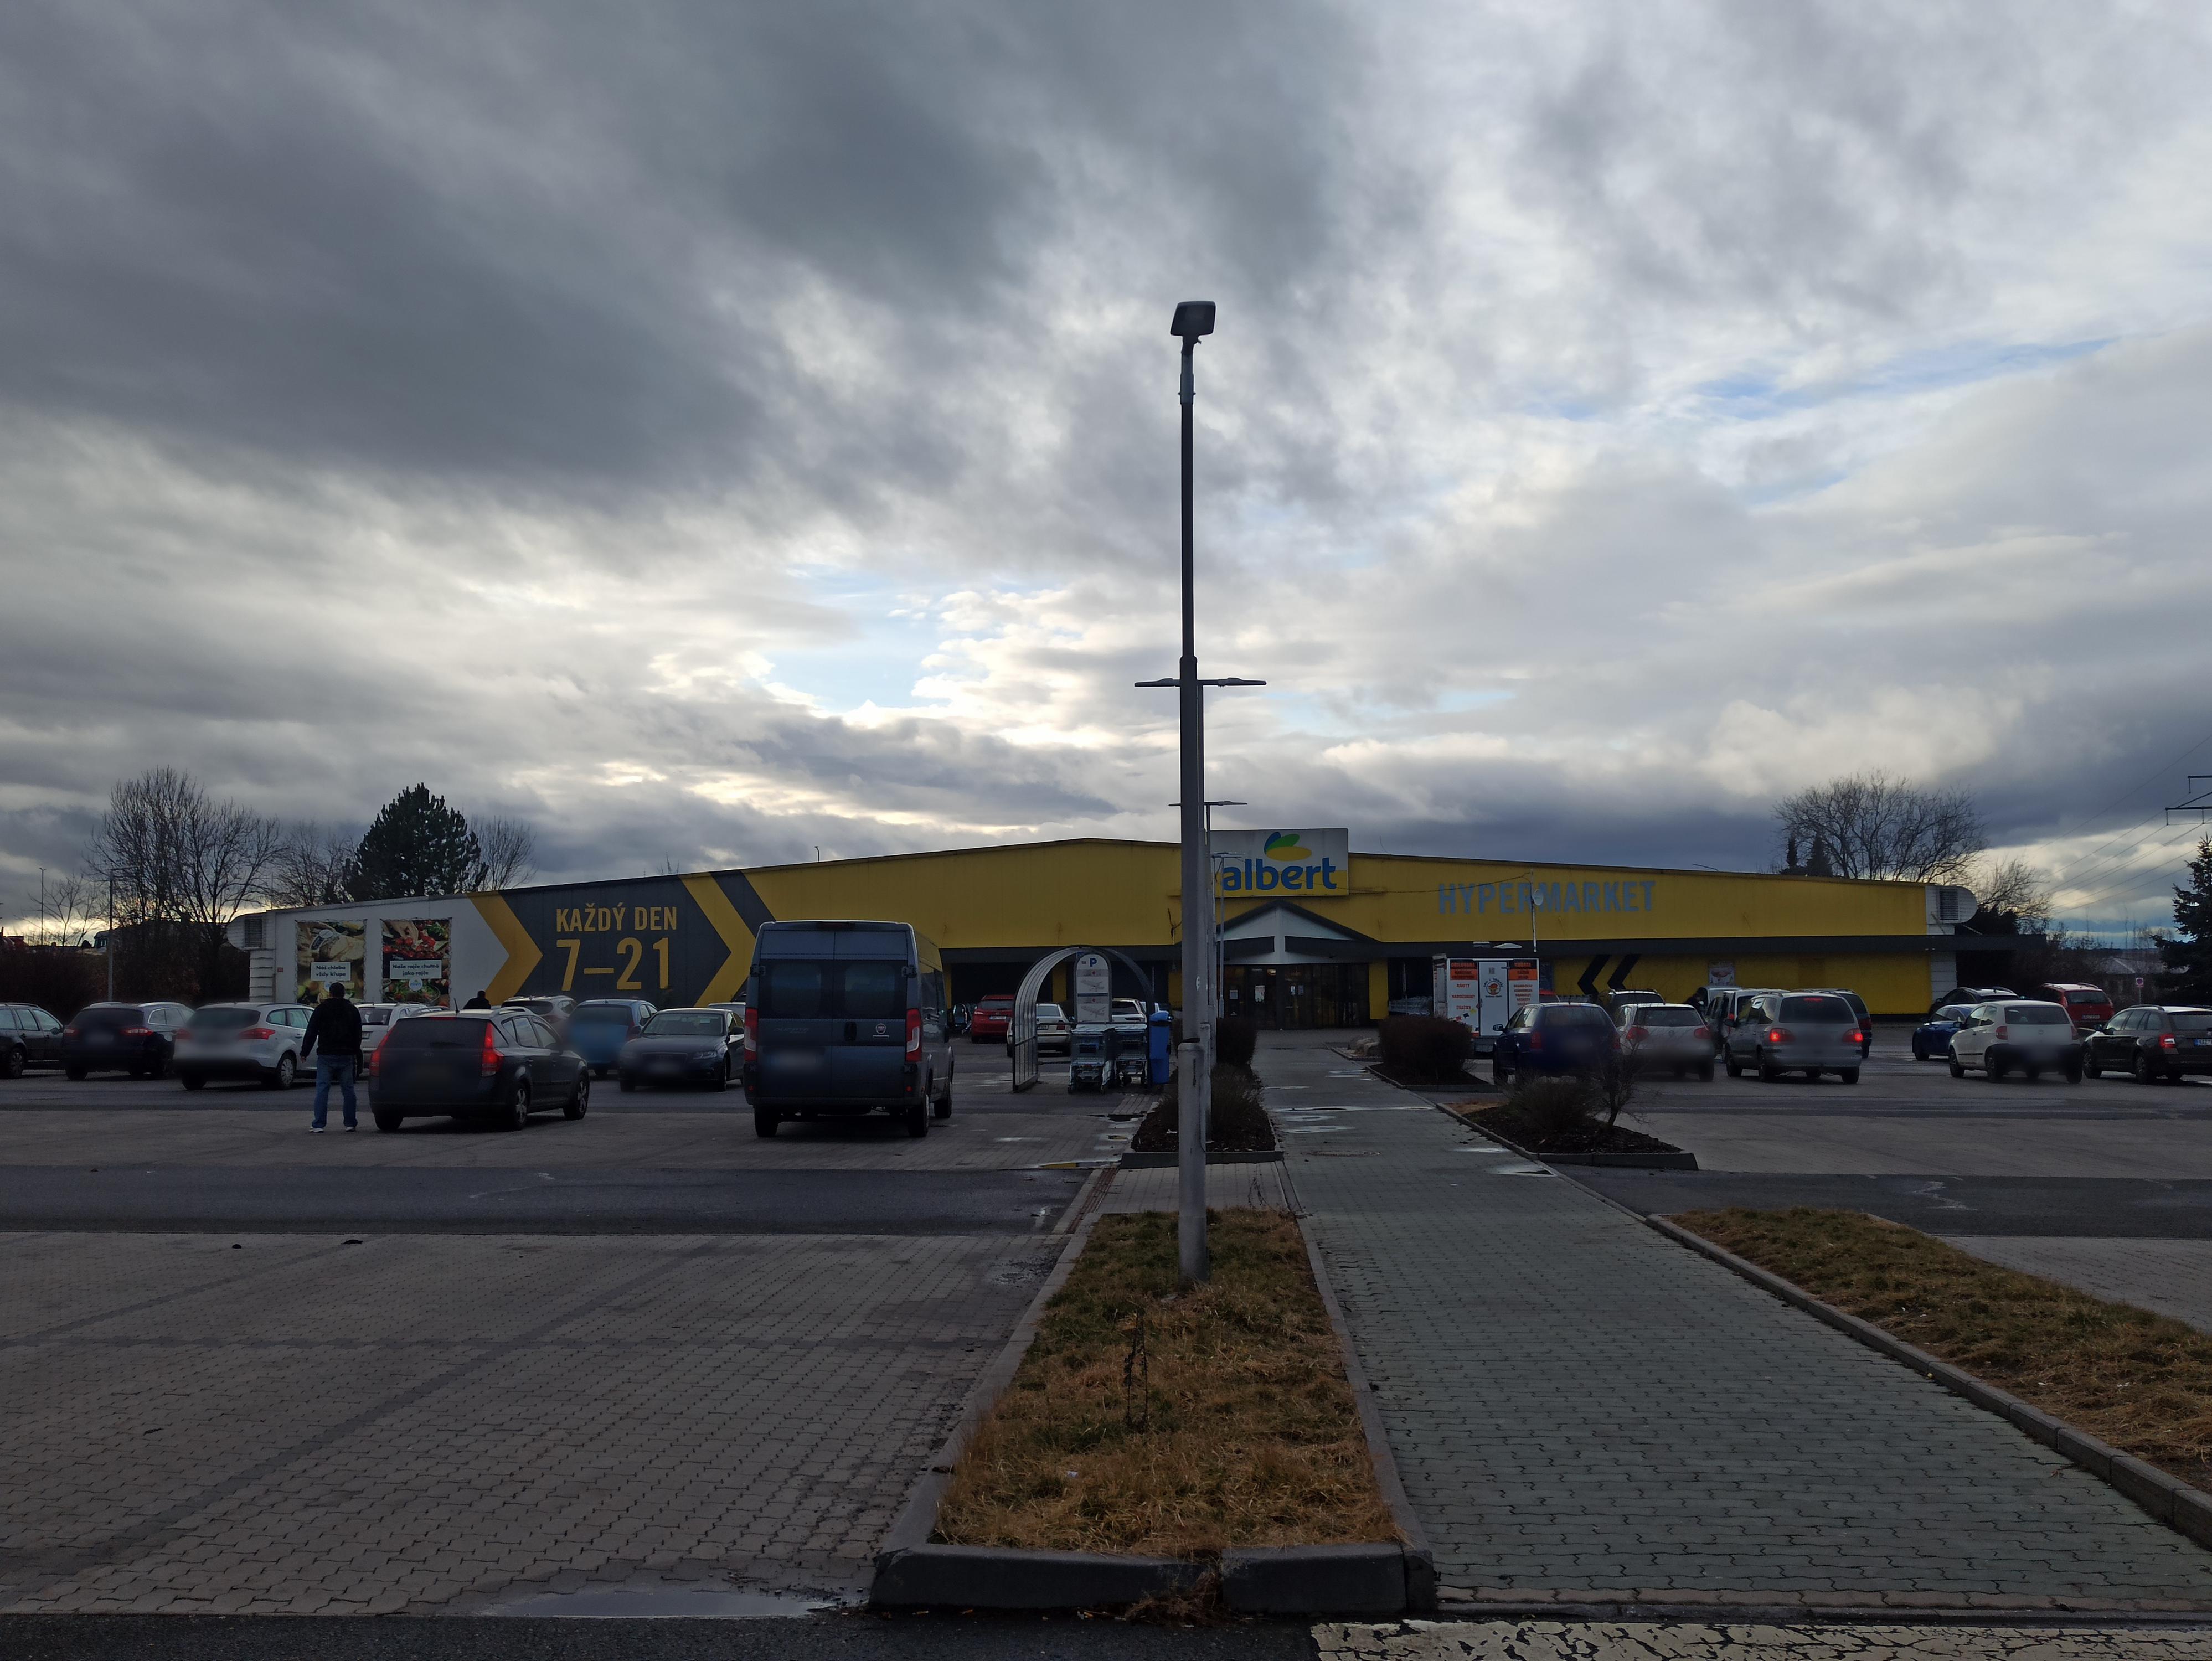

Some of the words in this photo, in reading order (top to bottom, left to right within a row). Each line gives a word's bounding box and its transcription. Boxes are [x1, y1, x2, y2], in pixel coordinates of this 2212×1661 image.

[1222, 857, 1337, 891] albert
[1438, 880, 1656, 915] HYPERMARKET
[556, 902, 626, 932] KAŽDÝ
[635, 906, 677, 931] DEN
[1089, 957, 1097, 967] P
